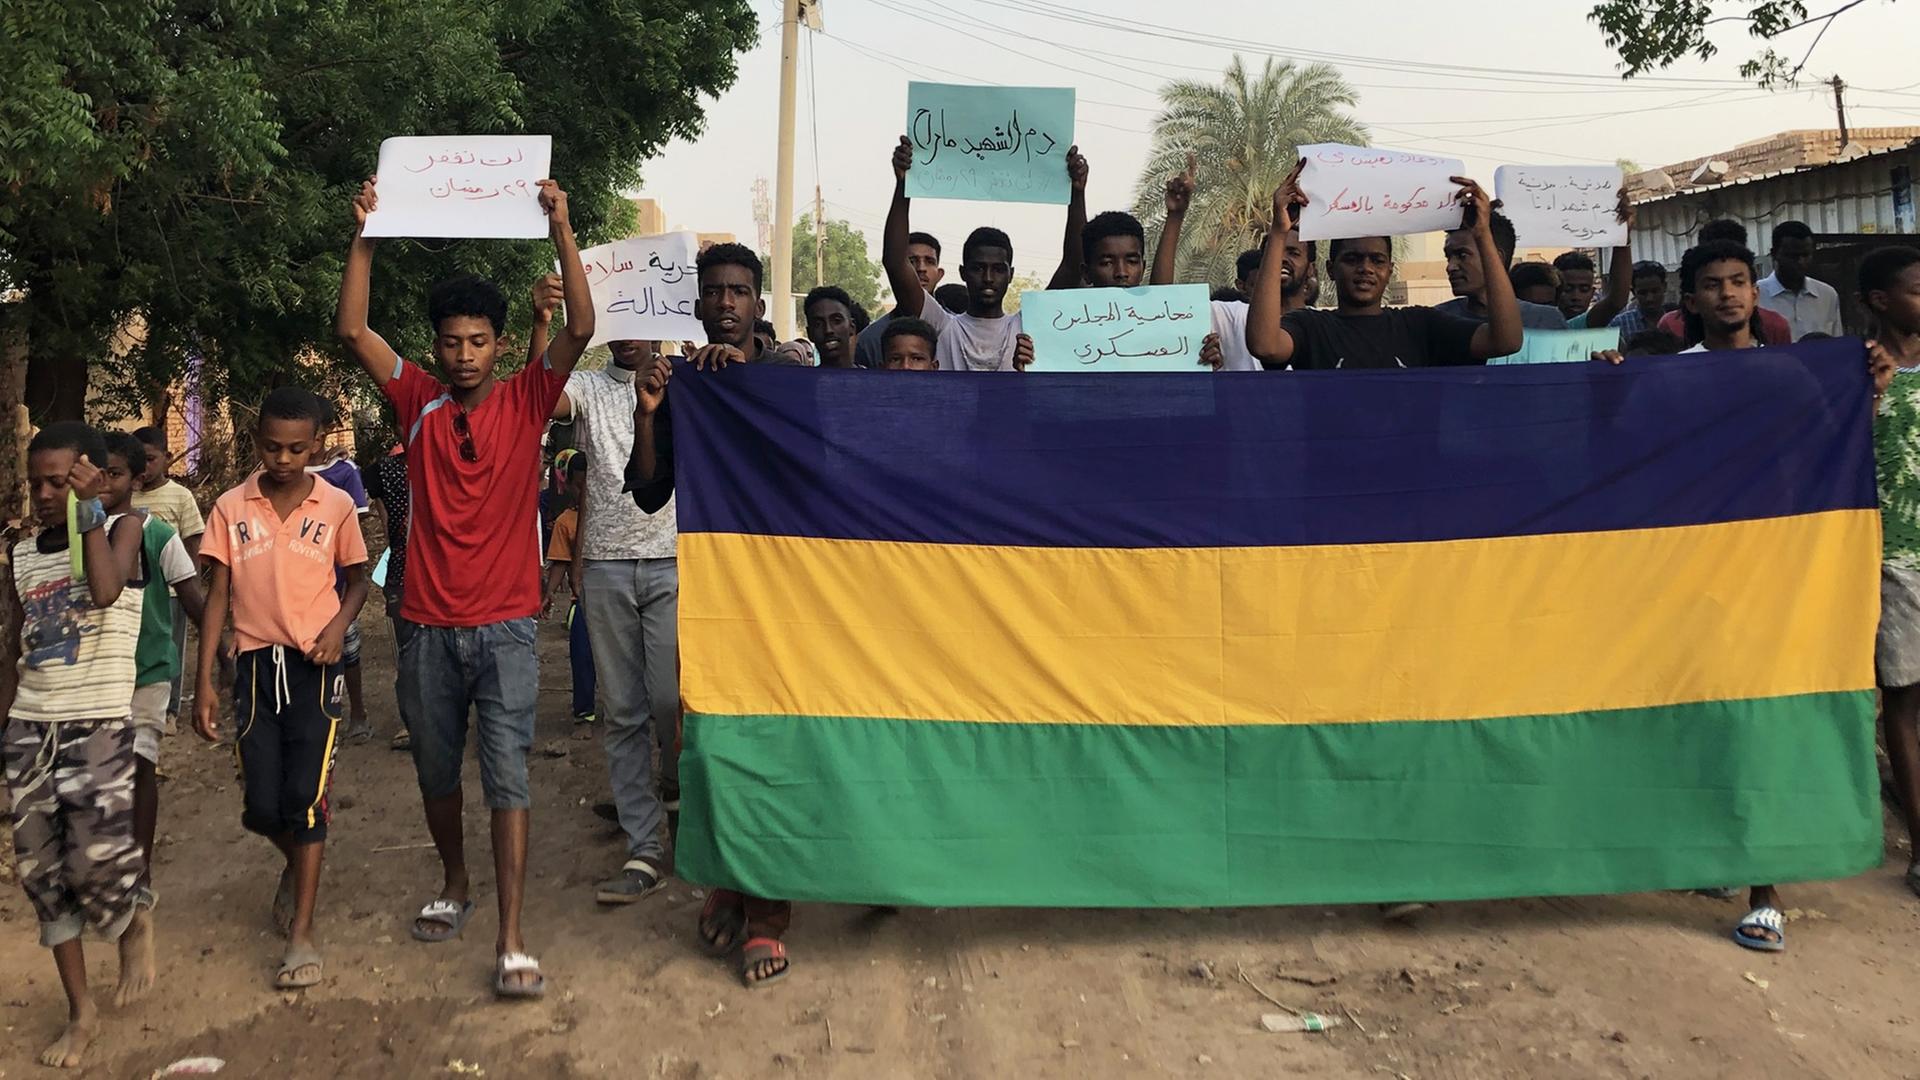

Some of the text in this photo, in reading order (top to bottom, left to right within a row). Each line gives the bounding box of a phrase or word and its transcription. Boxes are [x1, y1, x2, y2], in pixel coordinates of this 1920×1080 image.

[960, 108, 1022, 162] الشهيد
[1024, 127, 1057, 164] دم
[429, 176, 501, 201] رمضان
[1320, 187, 1374, 217] بالعسكر
[1383, 186, 1429, 215] محكومة
[606, 286, 692, 317] عدالة
[1052, 300, 1121, 331] المجلس
[1072, 328, 1190, 365] العسكري
